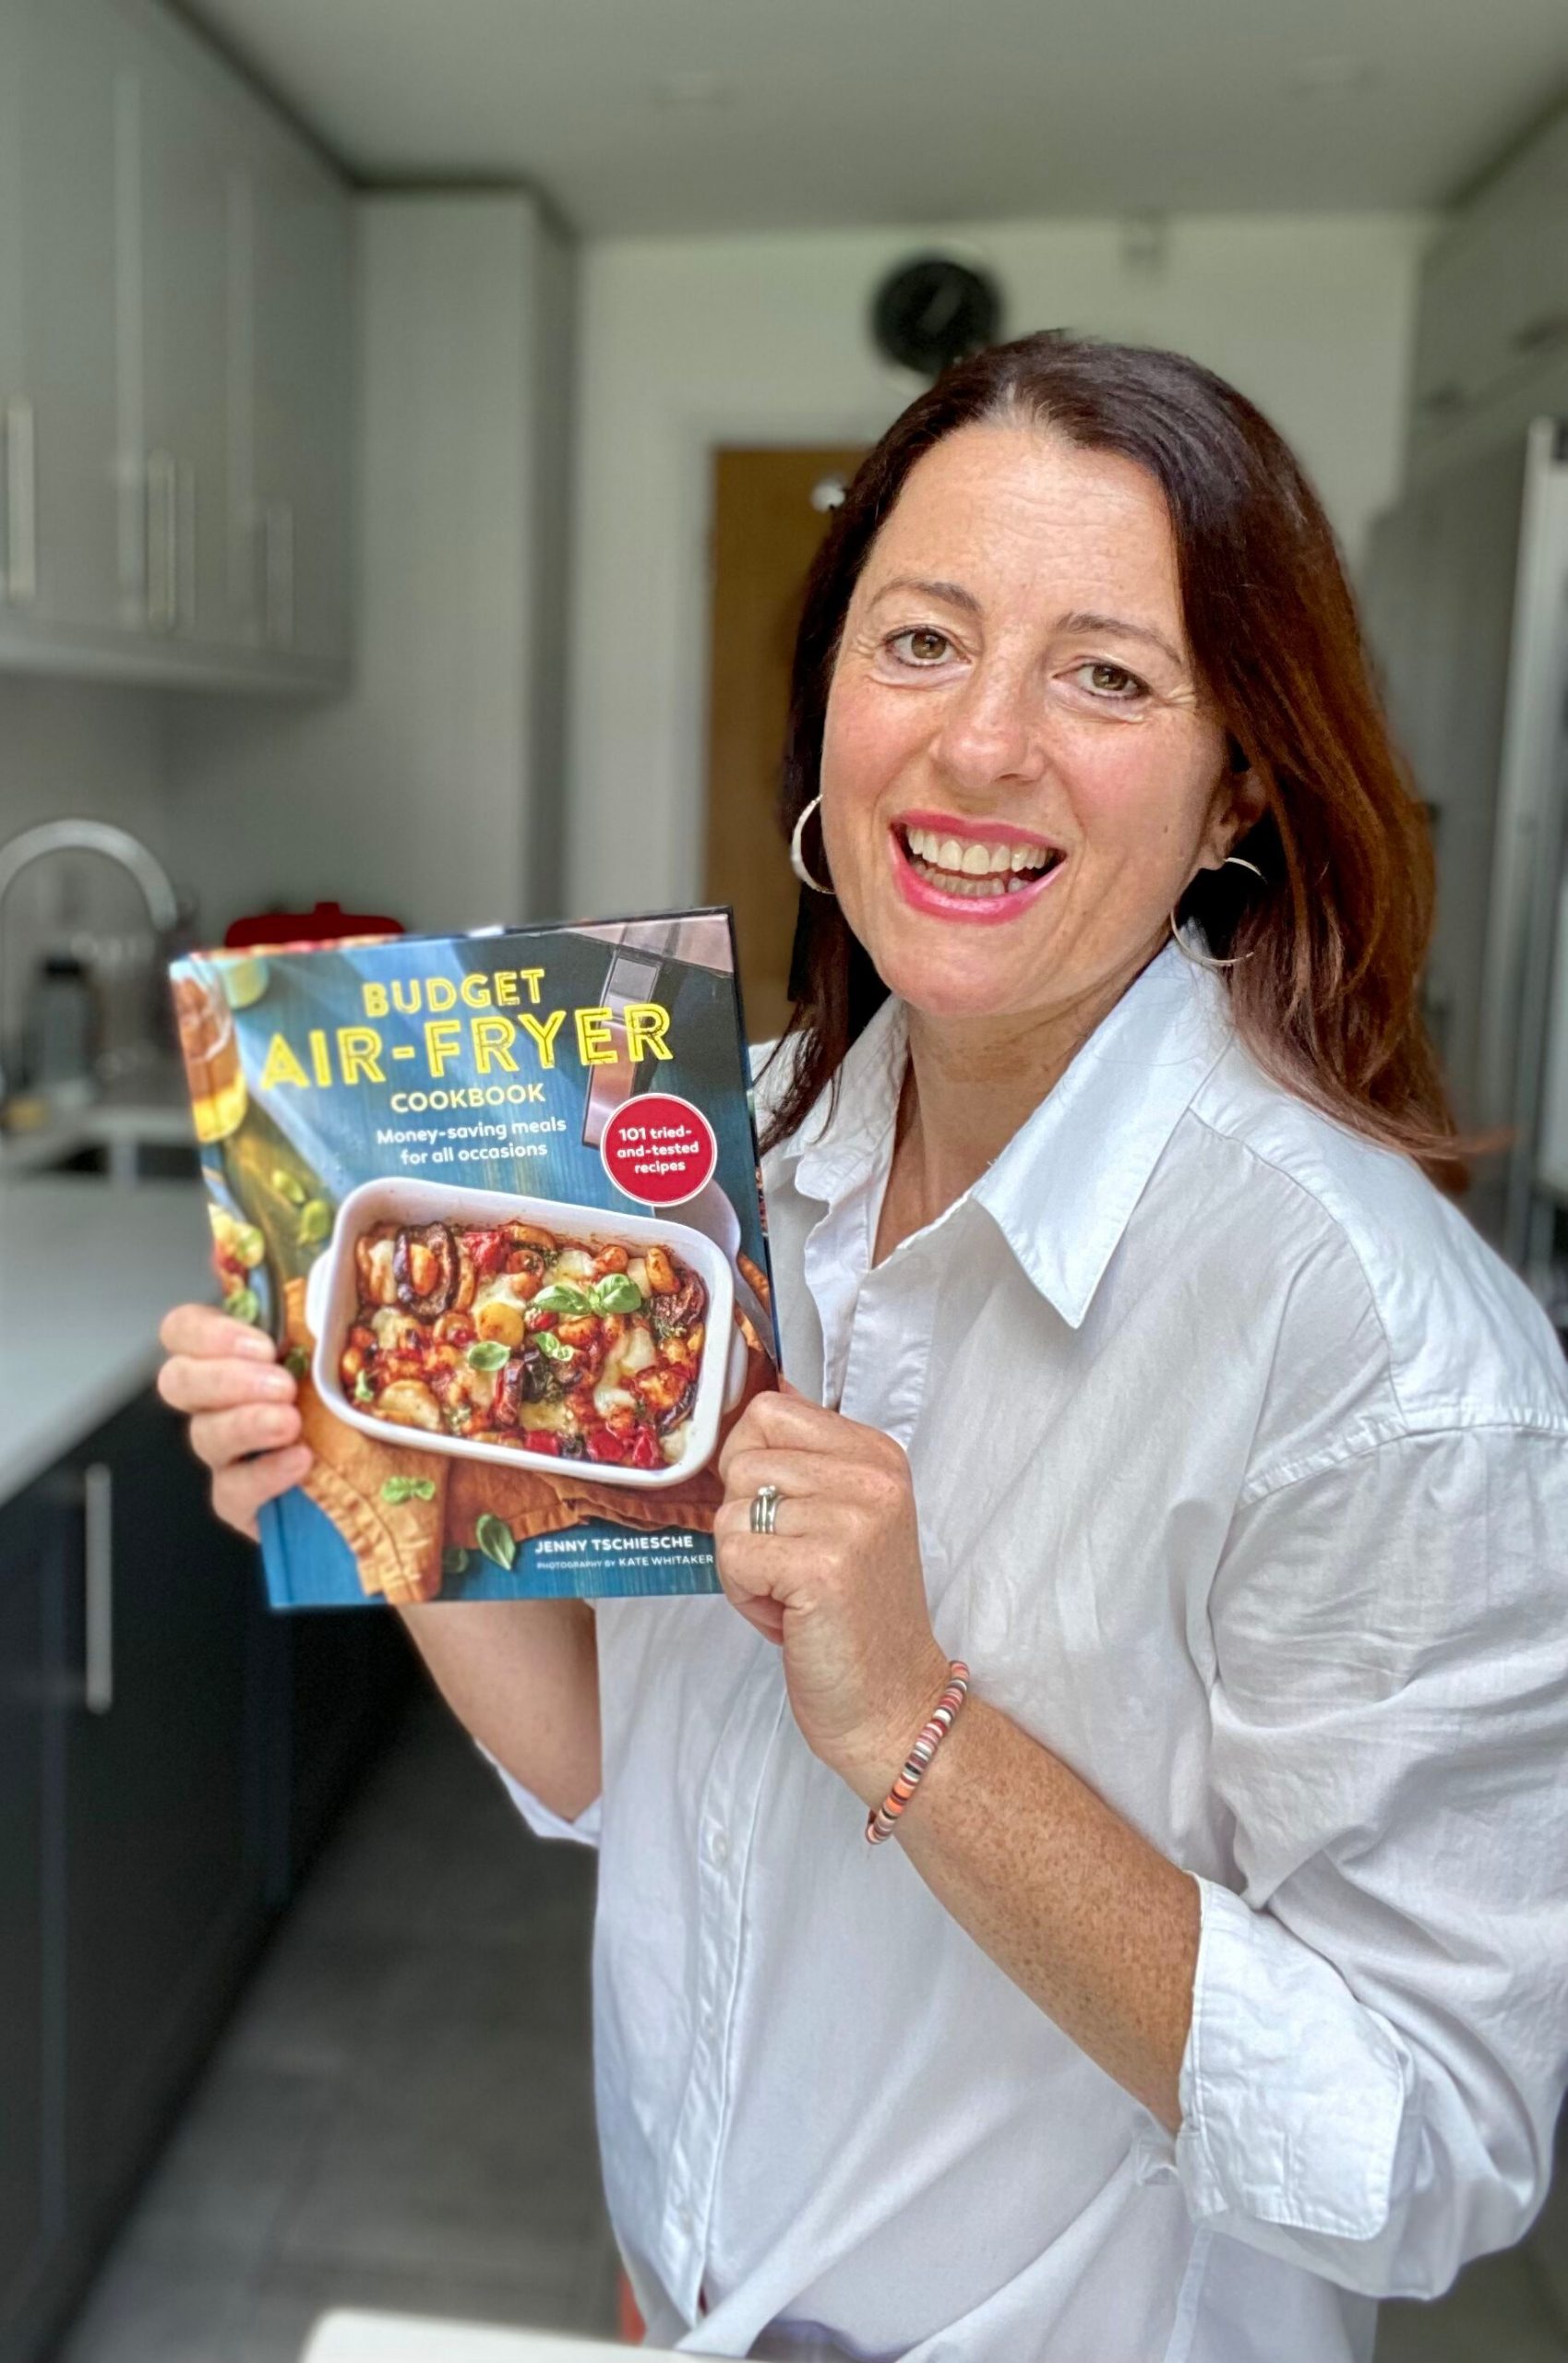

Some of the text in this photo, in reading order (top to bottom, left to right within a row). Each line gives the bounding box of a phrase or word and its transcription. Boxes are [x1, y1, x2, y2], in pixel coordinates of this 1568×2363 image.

[363, 968, 545, 1017] BUDGET
[260, 1002, 674, 1090] AIR-FRYER
[390, 1083, 545, 1113] COOKBOOK
[377, 1117, 567, 1145] Money-saving meals
[618, 1125, 692, 1141] 101 tried-
[401, 1143, 548, 1165] for all occasions
[616, 1141, 700, 1158] and-tested
[634, 1160, 686, 1175] recipes
[535, 1536, 693, 1553] JENNY TSCHIESCHE
[537, 1554, 714, 1569] PHOTOGRAPHY BY KATE WHITAKER
